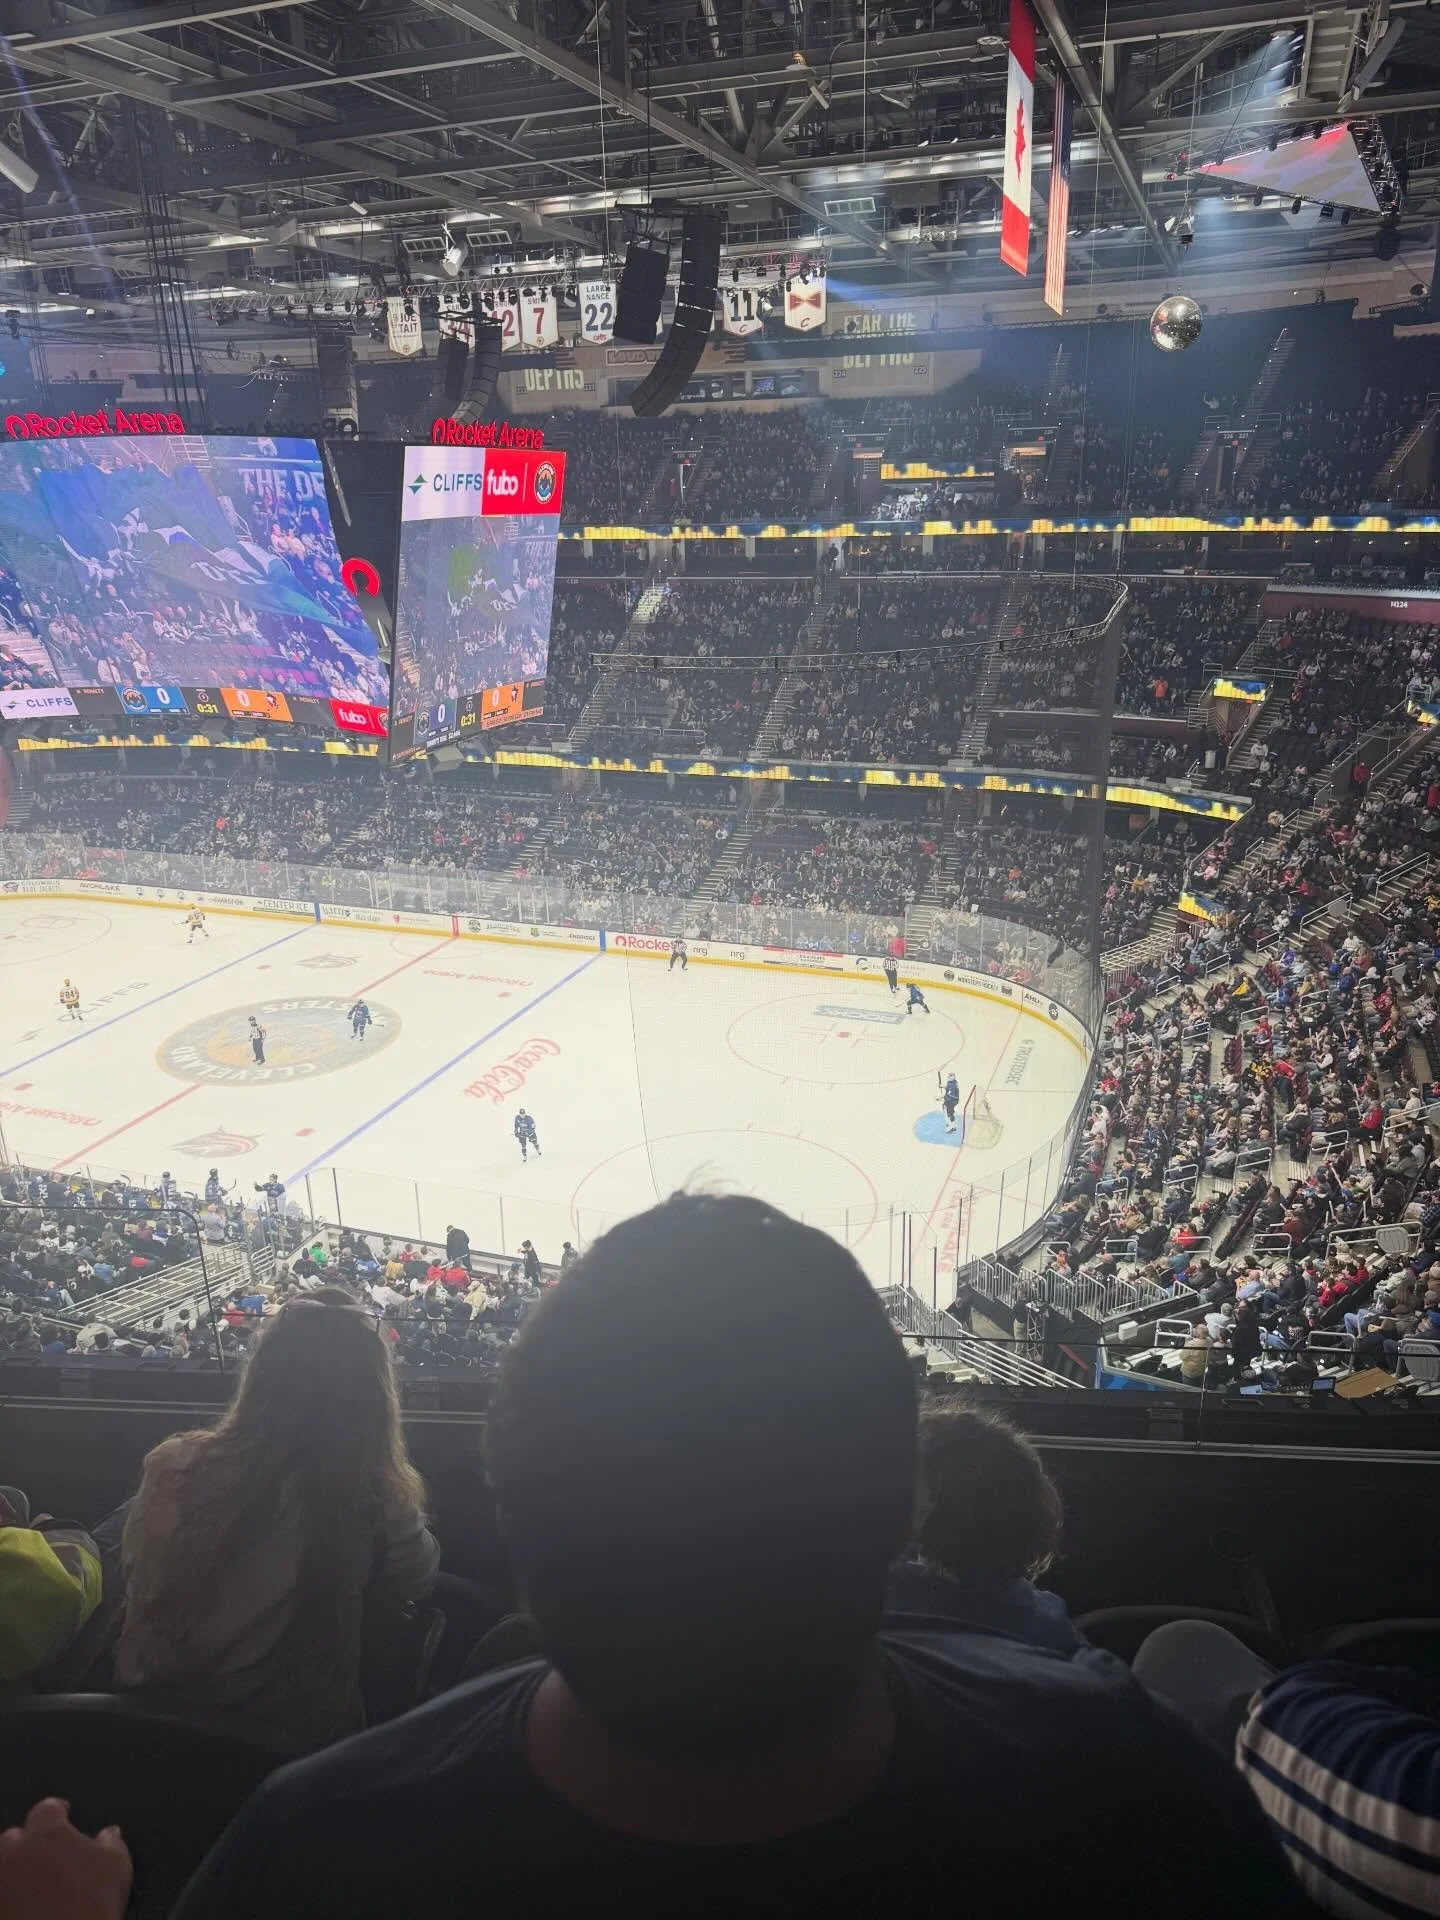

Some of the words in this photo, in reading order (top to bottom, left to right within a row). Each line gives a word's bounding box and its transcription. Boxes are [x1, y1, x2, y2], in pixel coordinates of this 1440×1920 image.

[533, 307, 544, 334] 7
[585, 302, 613, 331] 22
[399, 322, 418, 334] TAIT
[24, 410, 113, 439] Rocket
[114, 408, 186, 434] Arena
[445, 418, 498, 446] Rocket
[498, 422, 545, 449] Arena
[433, 473, 482, 492] CLIFFS
[487, 468, 519, 496] fubo
[1390, 600, 1408, 609] M124
[26, 697, 73, 708] CLIFFS
[156, 687, 170, 705] 0
[236, 690, 249, 707] 0
[491, 690, 499, 707] 0
[196, 703, 219, 714] 0:31
[339, 708, 368, 725] fubo
[437, 704, 446, 723] 0
[460, 712, 476, 728] 0:31
[263, 899, 295, 911] CENTER
[693, 947, 708, 957] nrg
[730, 950, 745, 961] nrg
[172, 1046, 319, 1081] CLEVELAND
